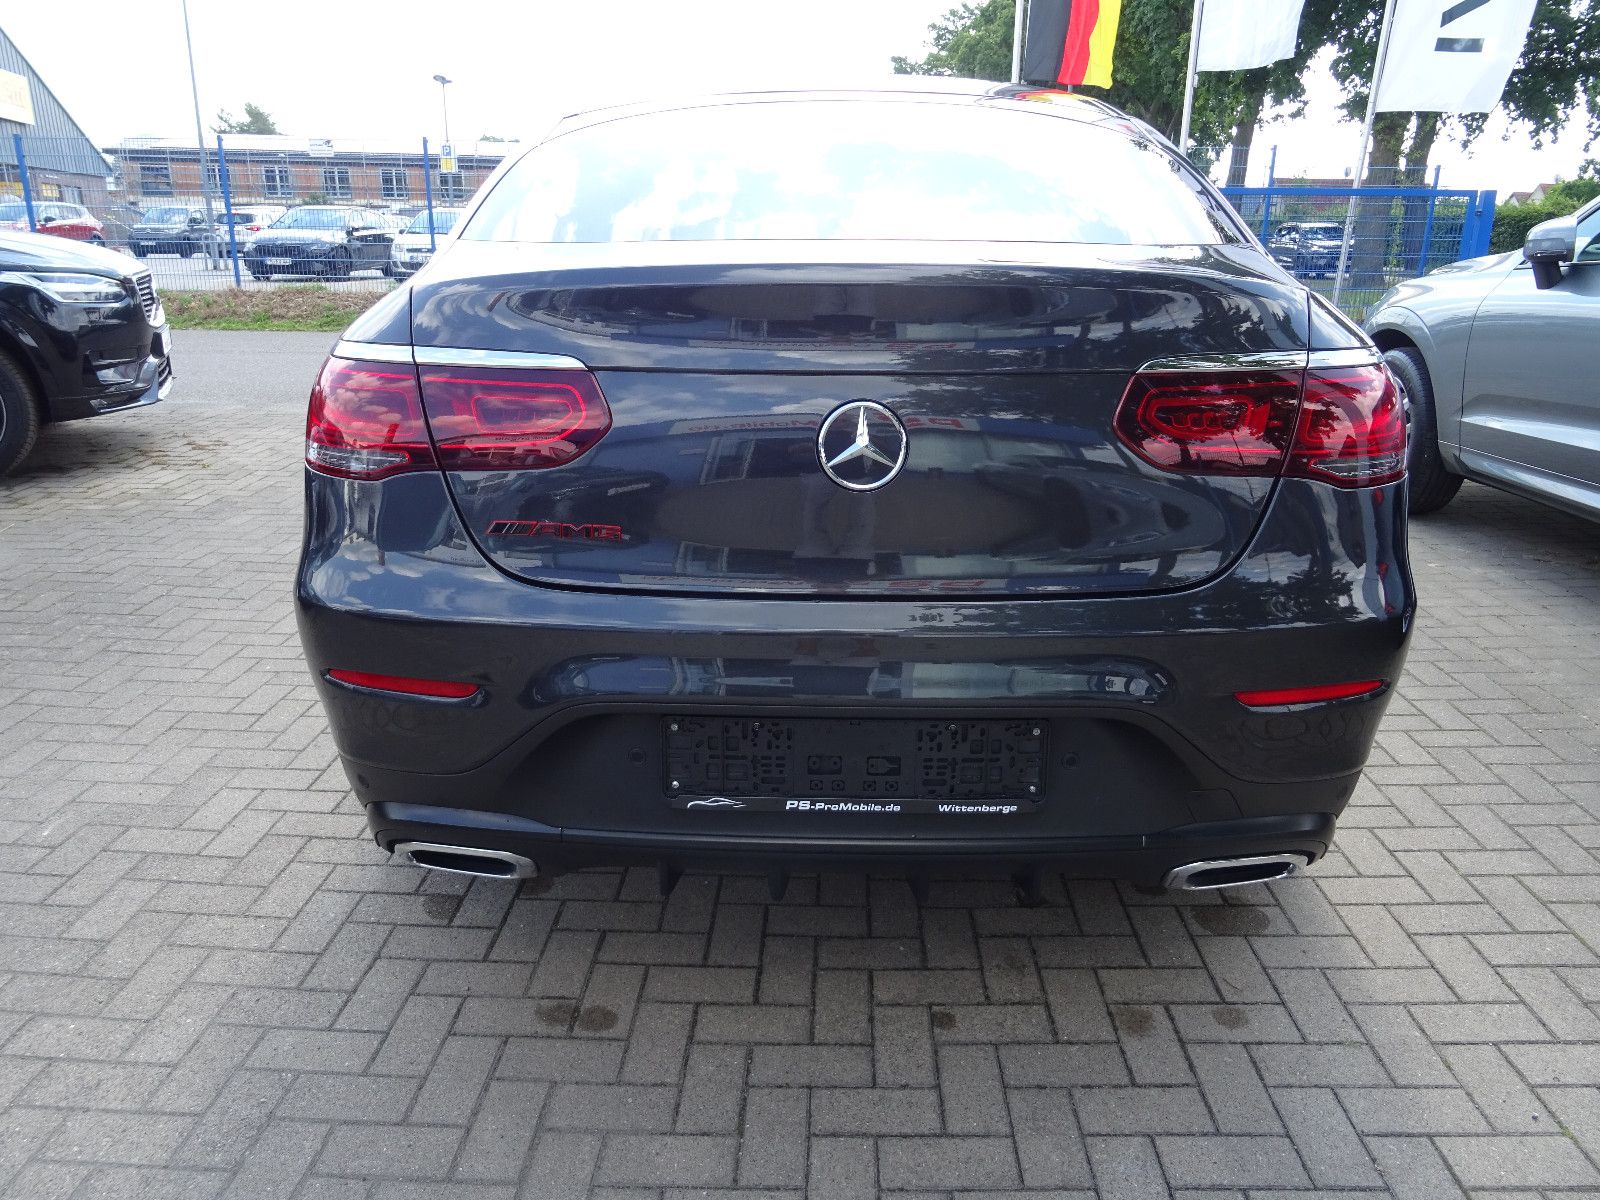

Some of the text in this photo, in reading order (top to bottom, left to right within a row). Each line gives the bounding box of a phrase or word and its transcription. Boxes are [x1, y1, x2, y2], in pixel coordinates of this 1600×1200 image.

[529, 521, 622, 541] AMG
[785, 800, 1018, 815] PS-ProMobile.de Wittenberge
